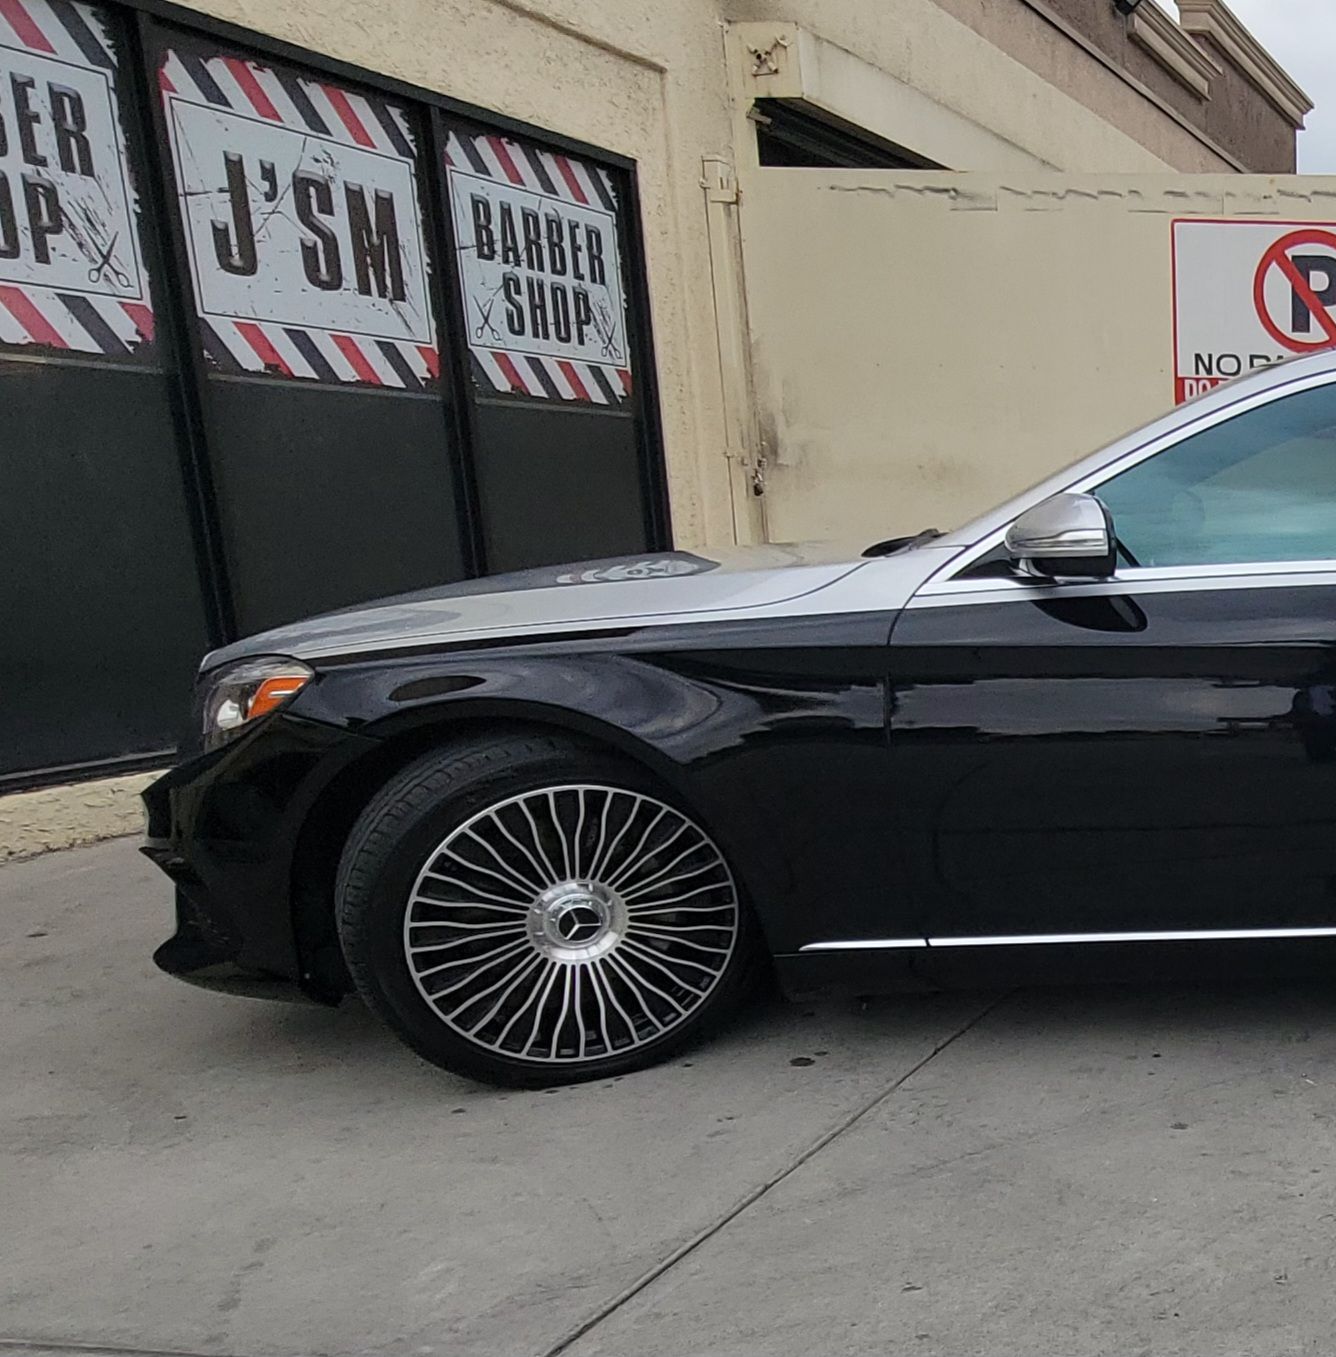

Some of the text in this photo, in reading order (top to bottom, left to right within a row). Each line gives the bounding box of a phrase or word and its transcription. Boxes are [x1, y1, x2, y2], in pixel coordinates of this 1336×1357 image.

[0, 71, 95, 177] ER
[210, 150, 406, 302] J'SM
[470, 192, 606, 286] BARBER
[503, 271, 591, 346] SHOP
[1194, 353, 1241, 377] NO
